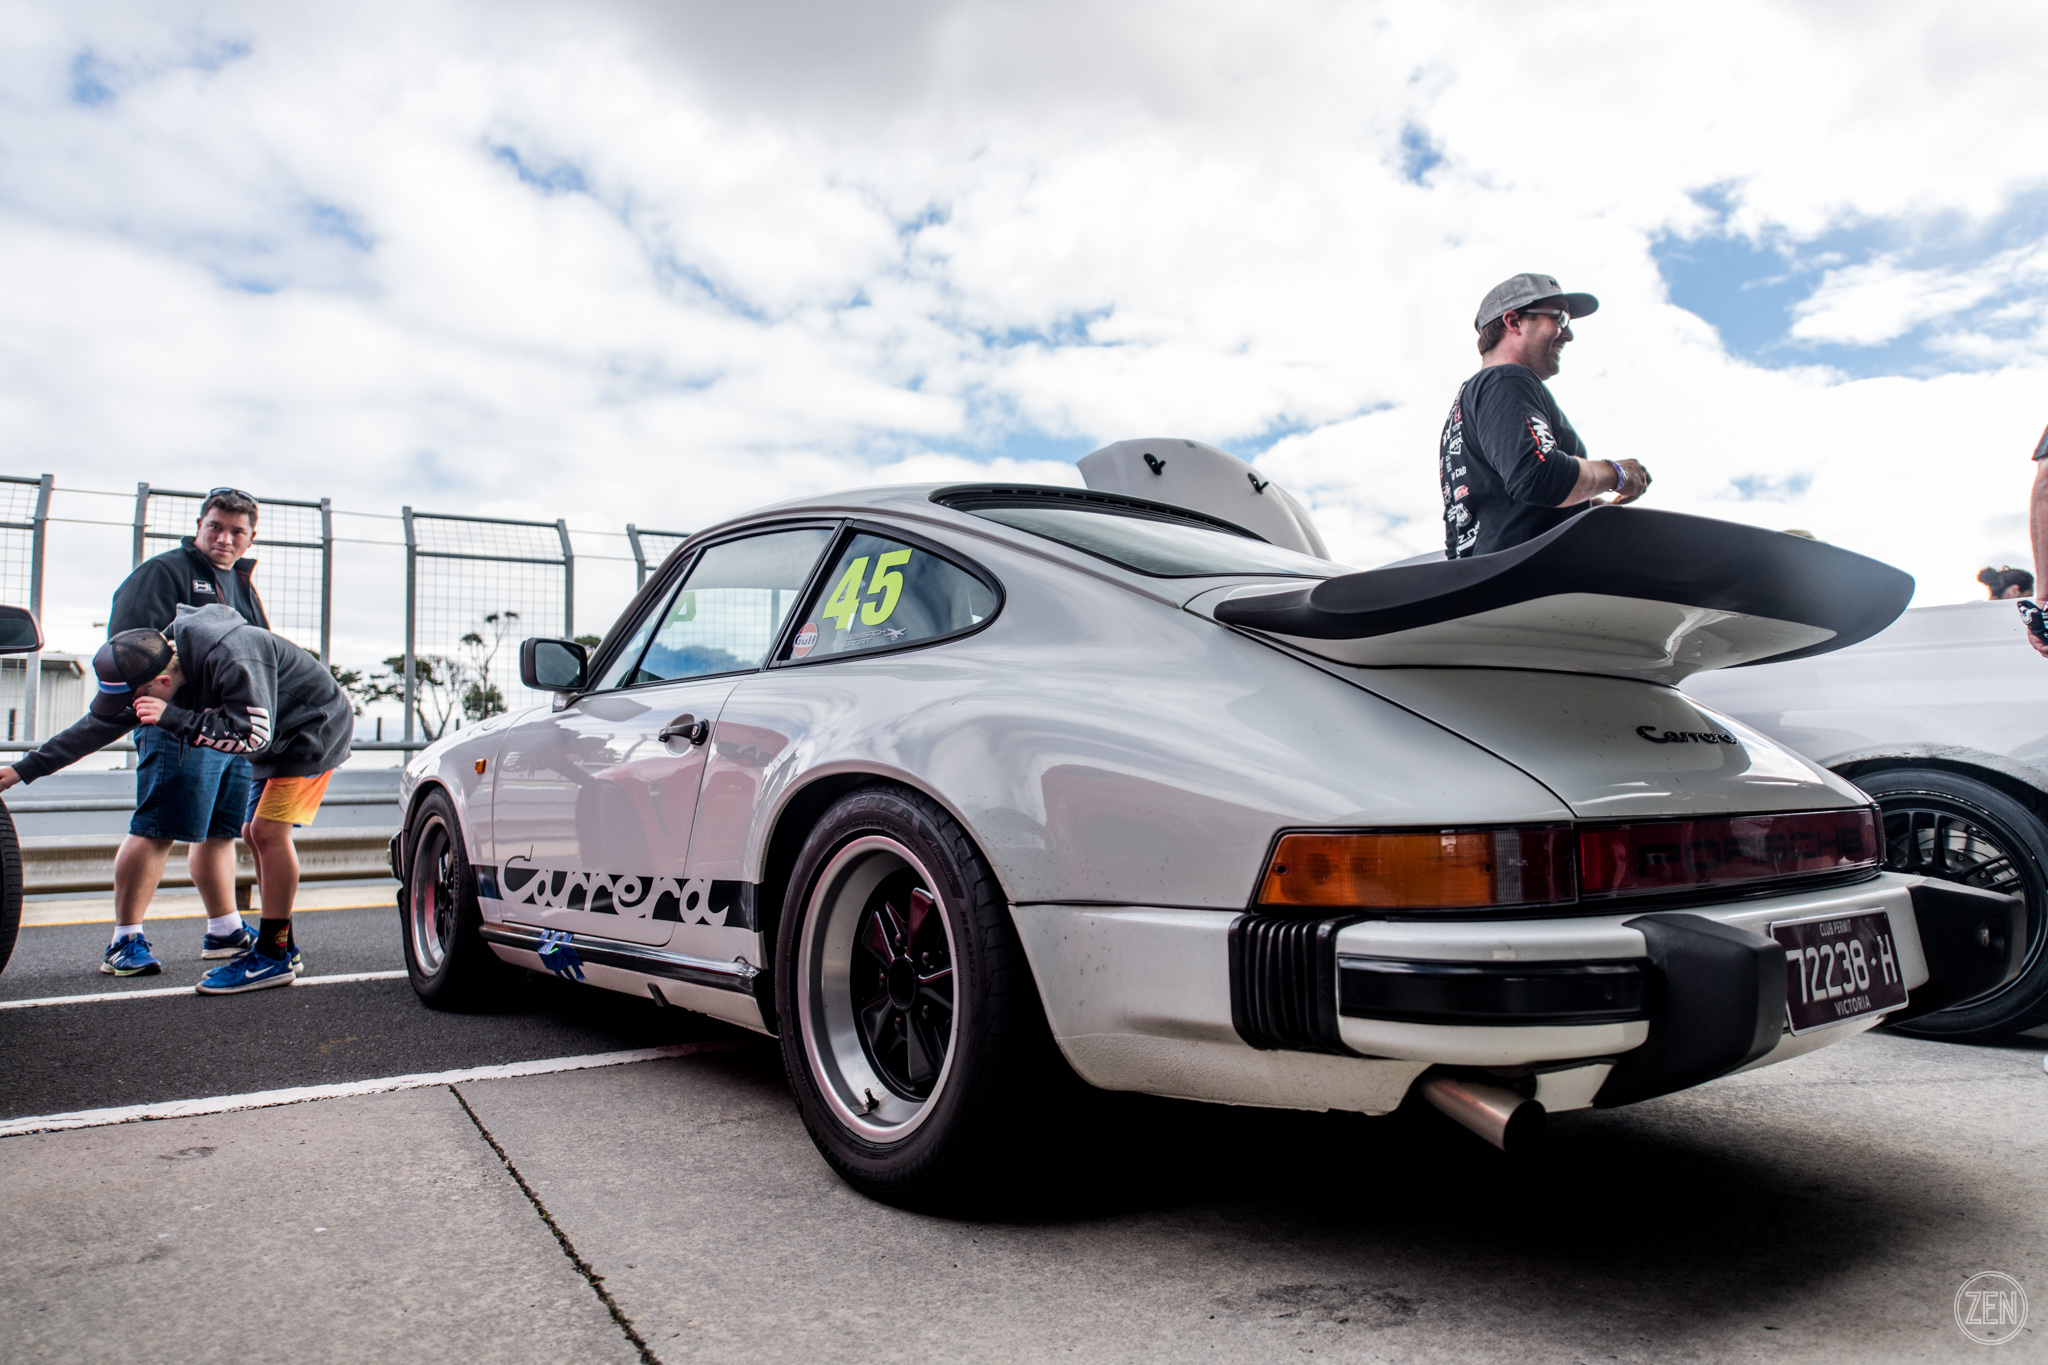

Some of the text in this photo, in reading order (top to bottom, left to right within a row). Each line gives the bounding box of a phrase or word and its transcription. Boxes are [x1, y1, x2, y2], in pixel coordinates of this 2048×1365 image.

[822, 548, 913, 630] 45
[794, 634, 817, 646] Gulf
[1636, 725, 1738, 745] Carrera
[1637, 827, 1863, 877] PORSCHE
[498, 844, 730, 927] Carrera
[1819, 919, 1853, 937] CLUB PERMIT
[1834, 995, 1872, 1016] VICTORIA
